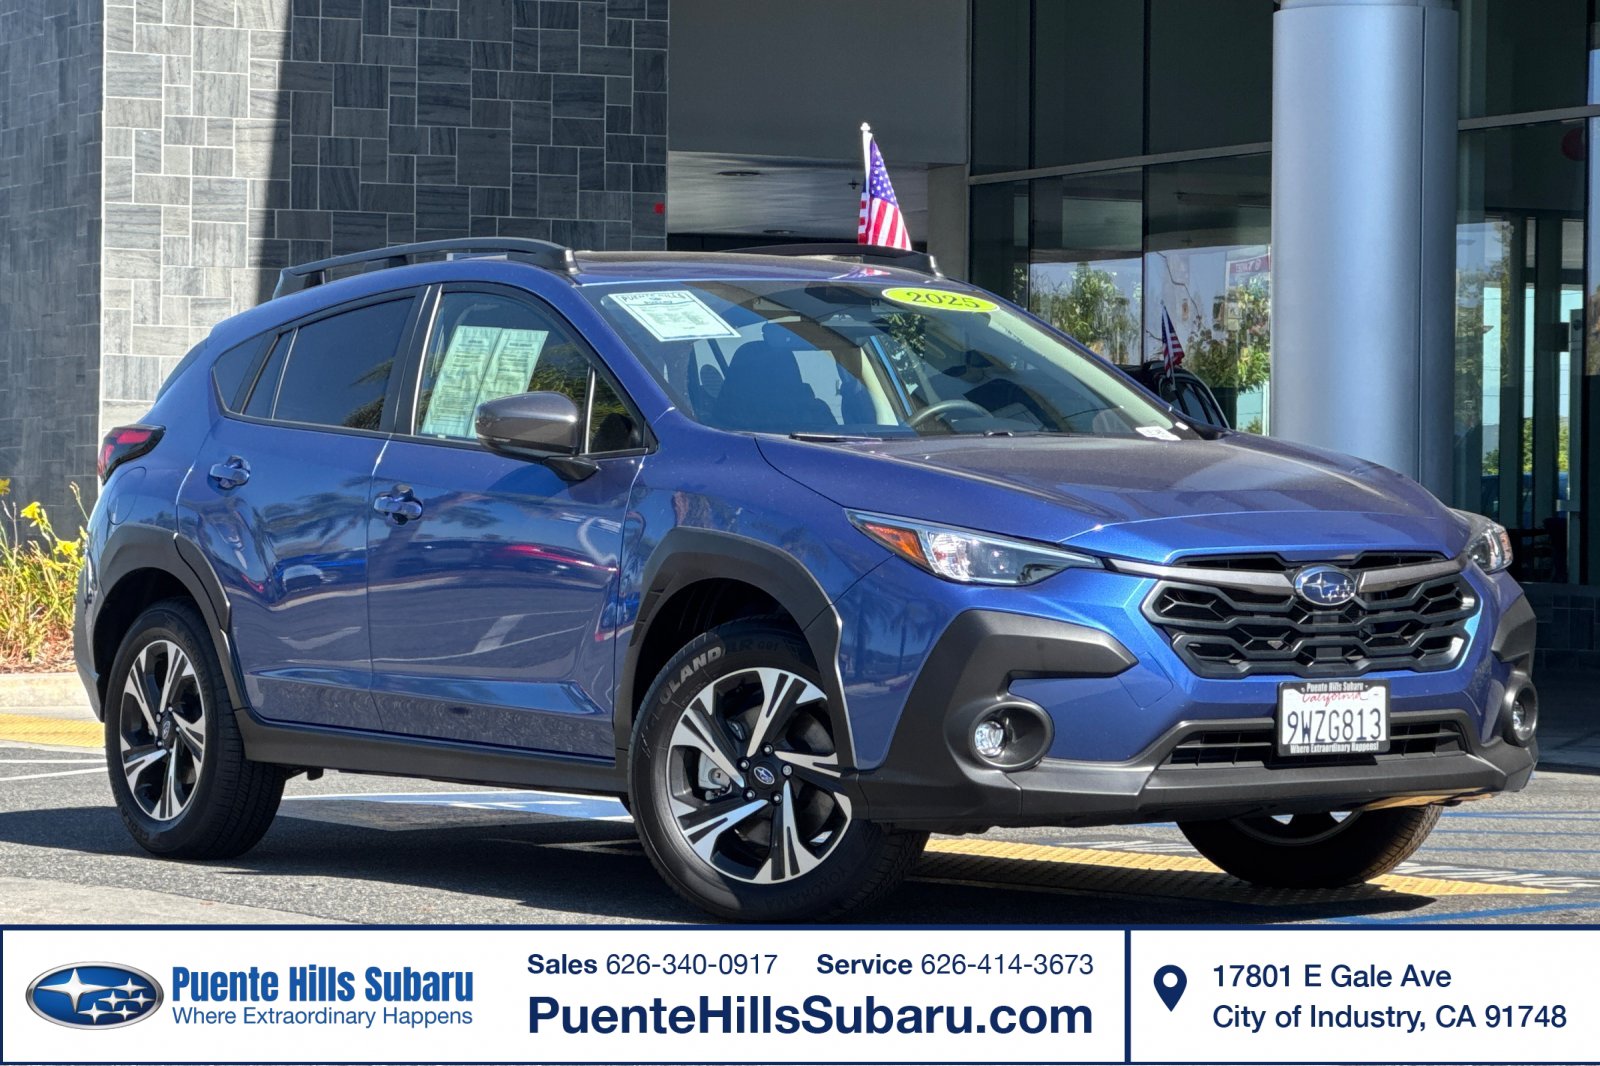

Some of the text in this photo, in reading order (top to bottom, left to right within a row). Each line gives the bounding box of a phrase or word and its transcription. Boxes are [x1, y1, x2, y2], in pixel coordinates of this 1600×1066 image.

[906, 291, 980, 308] 2025
[1306, 681, 1364, 692] Puente Hills Subaru
[1287, 707, 1382, 744] 9WZG813
[1290, 743, 1310, 754] Where
[1310, 742, 1351, 753] Extraordinary
